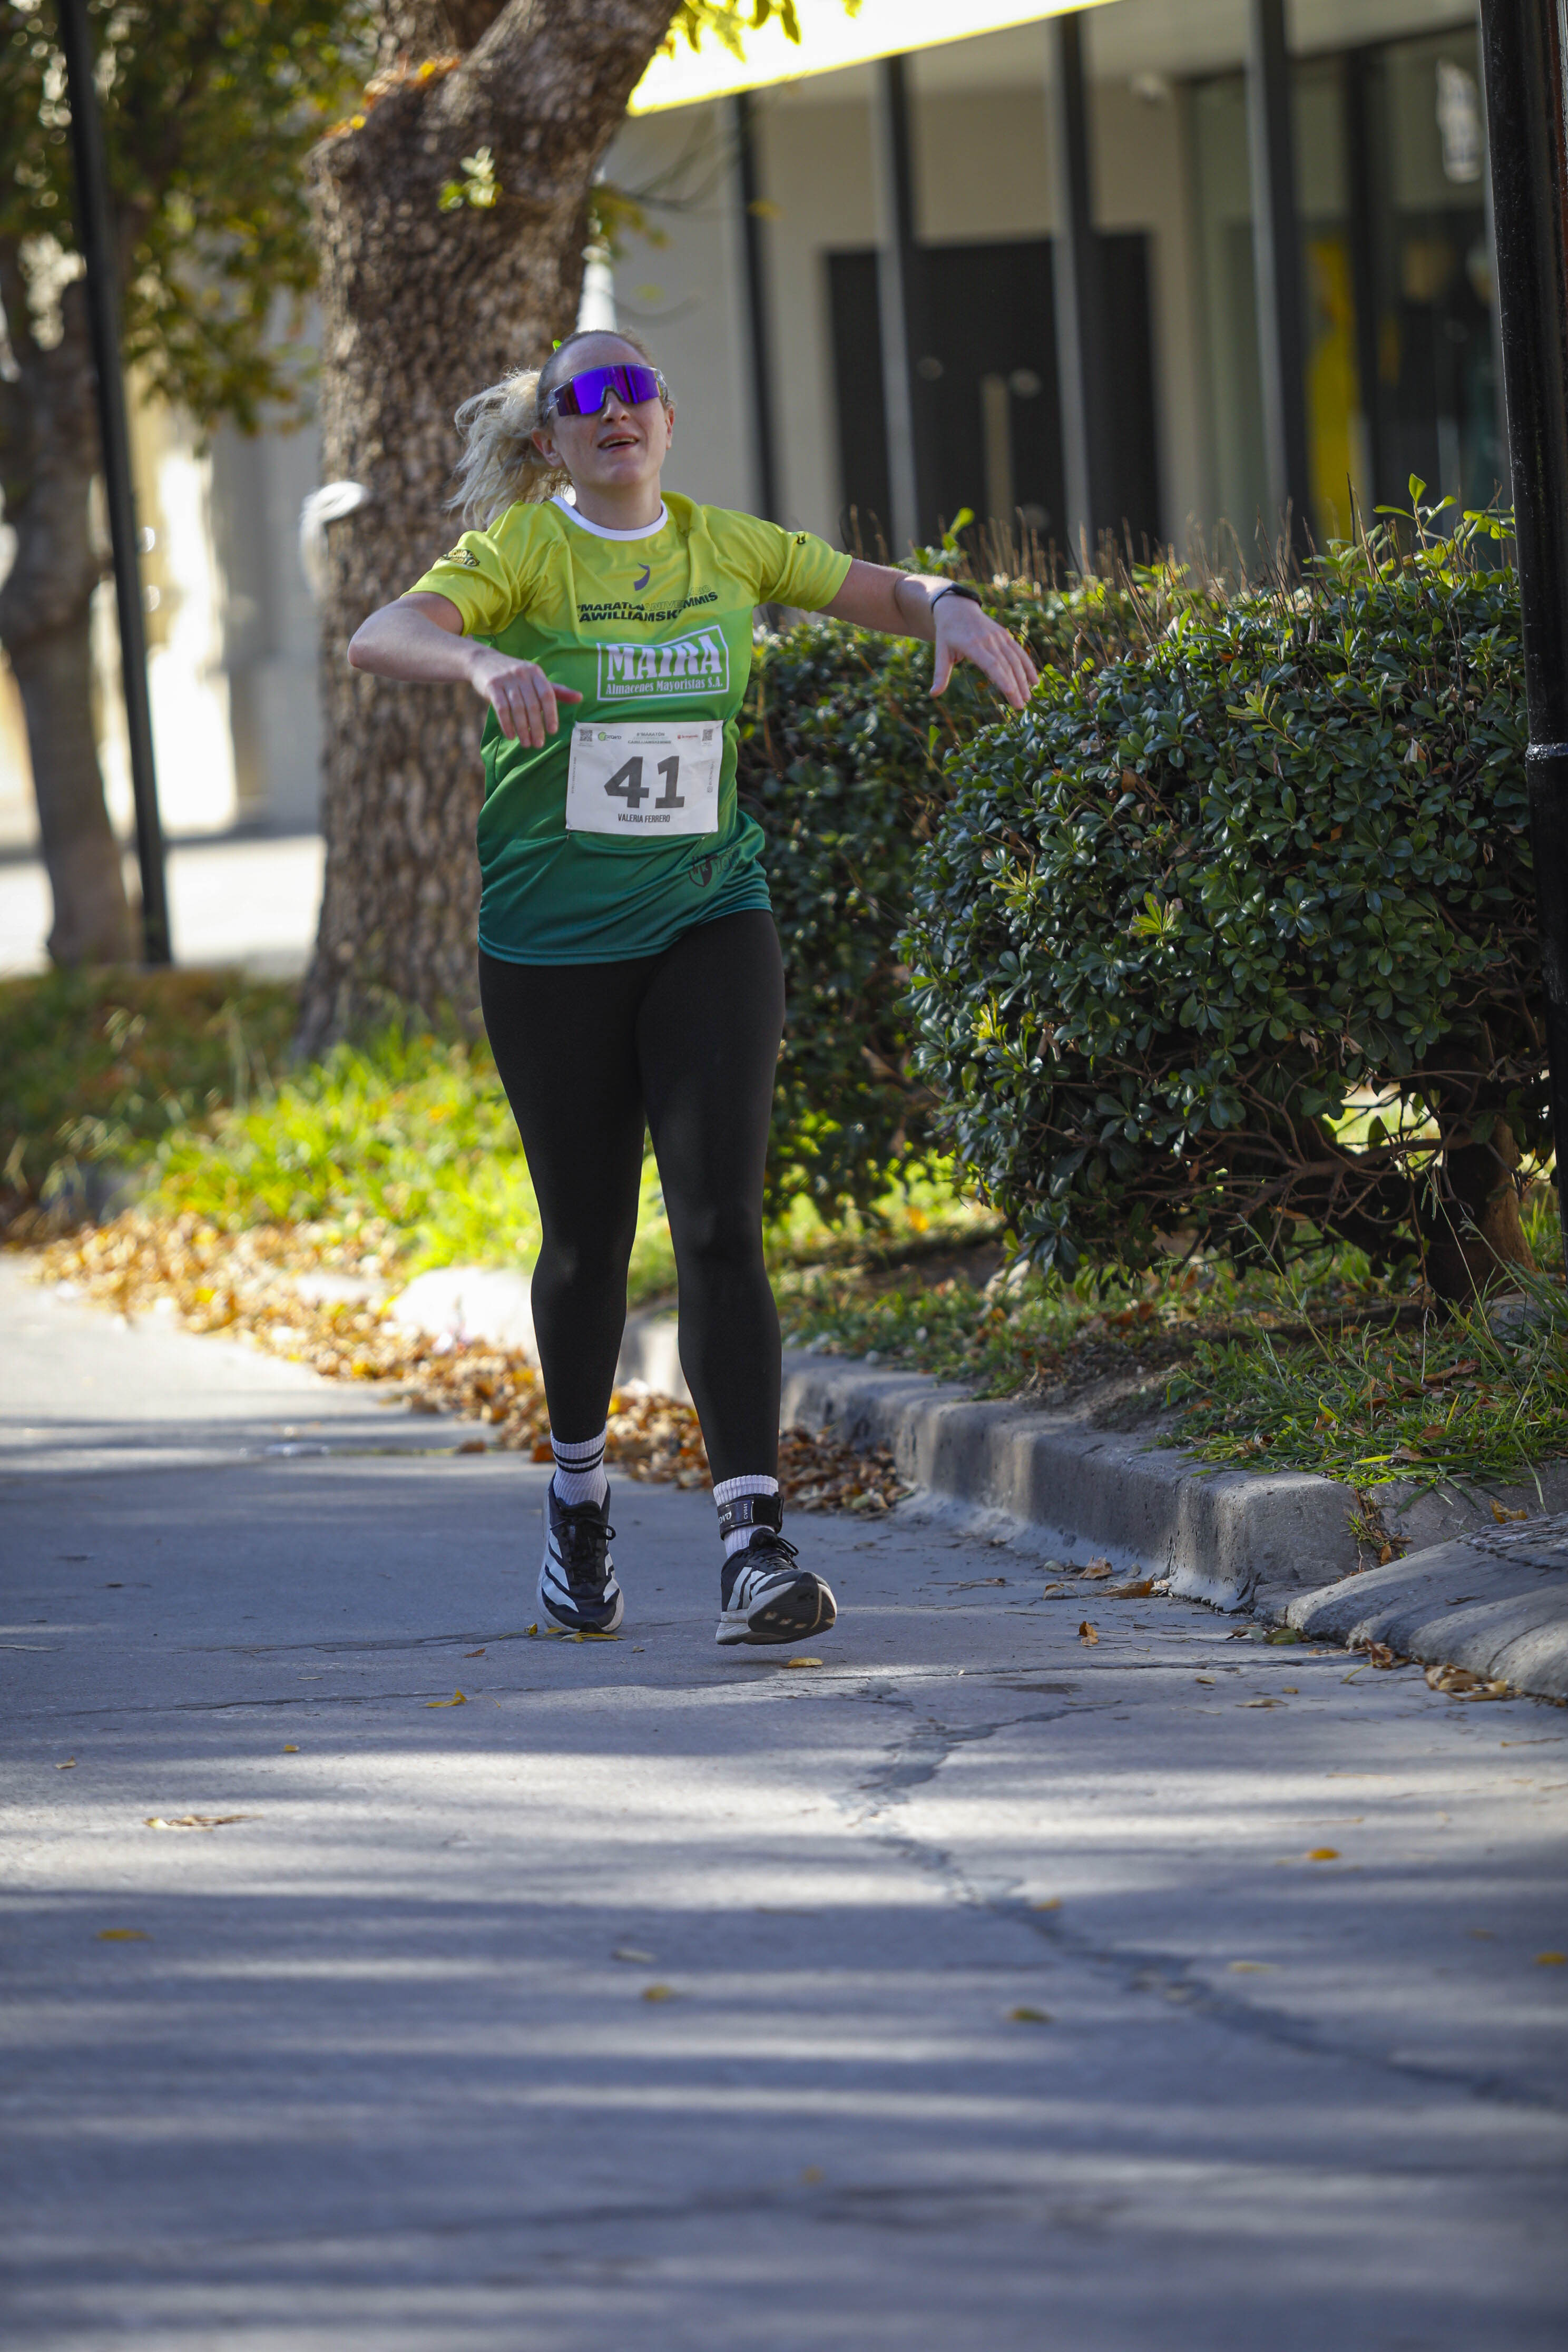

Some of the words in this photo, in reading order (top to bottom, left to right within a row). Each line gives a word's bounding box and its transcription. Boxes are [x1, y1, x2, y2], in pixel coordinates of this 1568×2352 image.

[606, 634, 722, 681] MAIRA
[606, 683, 654, 694] Almacenes
[656, 678, 705, 691] Mayoristas
[708, 676, 723, 688] S.A.
[604, 756, 685, 809] 41
[618, 813, 643, 823] VALERIA
[644, 815, 671, 823] FERRERO
